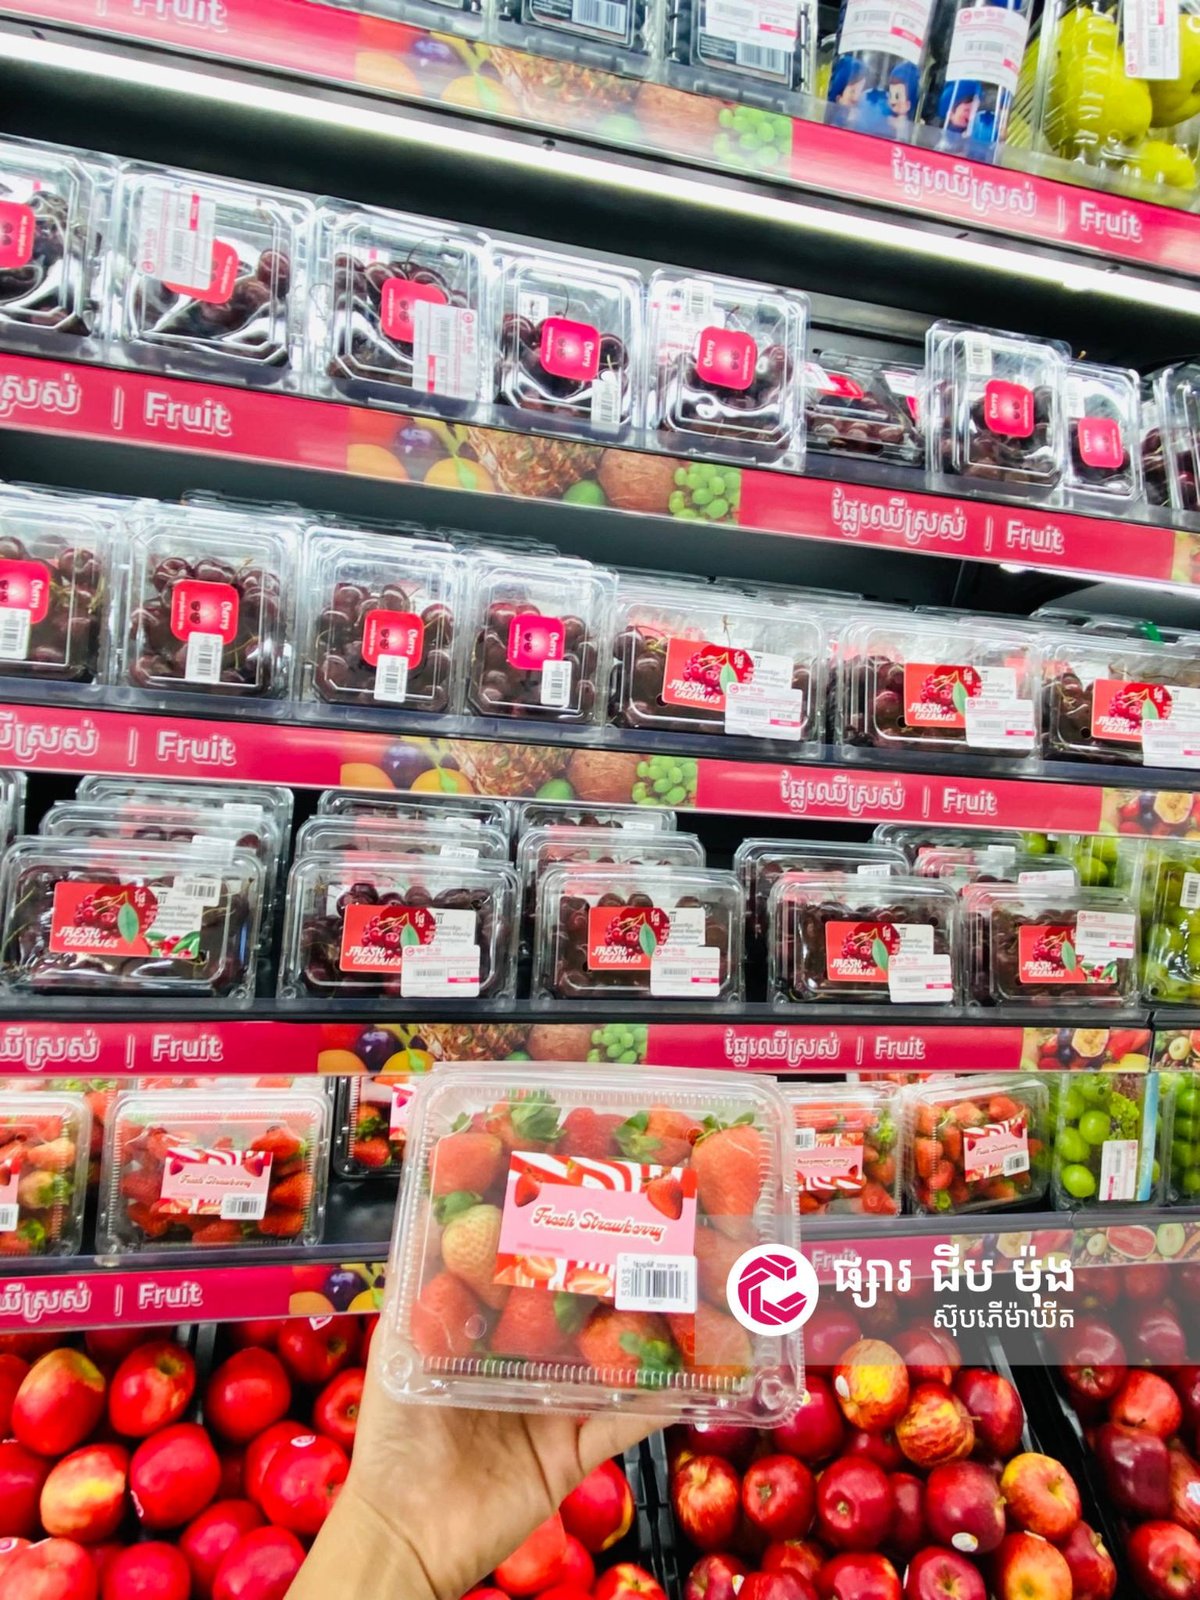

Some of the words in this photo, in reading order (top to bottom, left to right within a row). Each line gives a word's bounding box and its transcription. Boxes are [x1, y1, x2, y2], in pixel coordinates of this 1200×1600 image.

[132, 0, 228, 32] ruit
[1079, 201, 1143, 243] Fruit
[144, 389, 233, 437] Fruit
[831, 487, 967, 544] ផ្លែឈើស្រស់
[1006, 518, 1065, 555] Fruit
[157, 730, 237, 767] Fruit
[780, 769, 906, 816] ផ្លែឈើស្រស់
[942, 787, 998, 816] Fruit
[152, 1033, 225, 1063] Fruit
[724, 1028, 840, 1068] ផ្លែឈើស្រស់
[874, 1035, 926, 1060] Fruit
[532, 1206, 575, 1228] Fresh
[579, 1211, 665, 1243] Strawberry
[138, 1280, 203, 1309] Fruit
